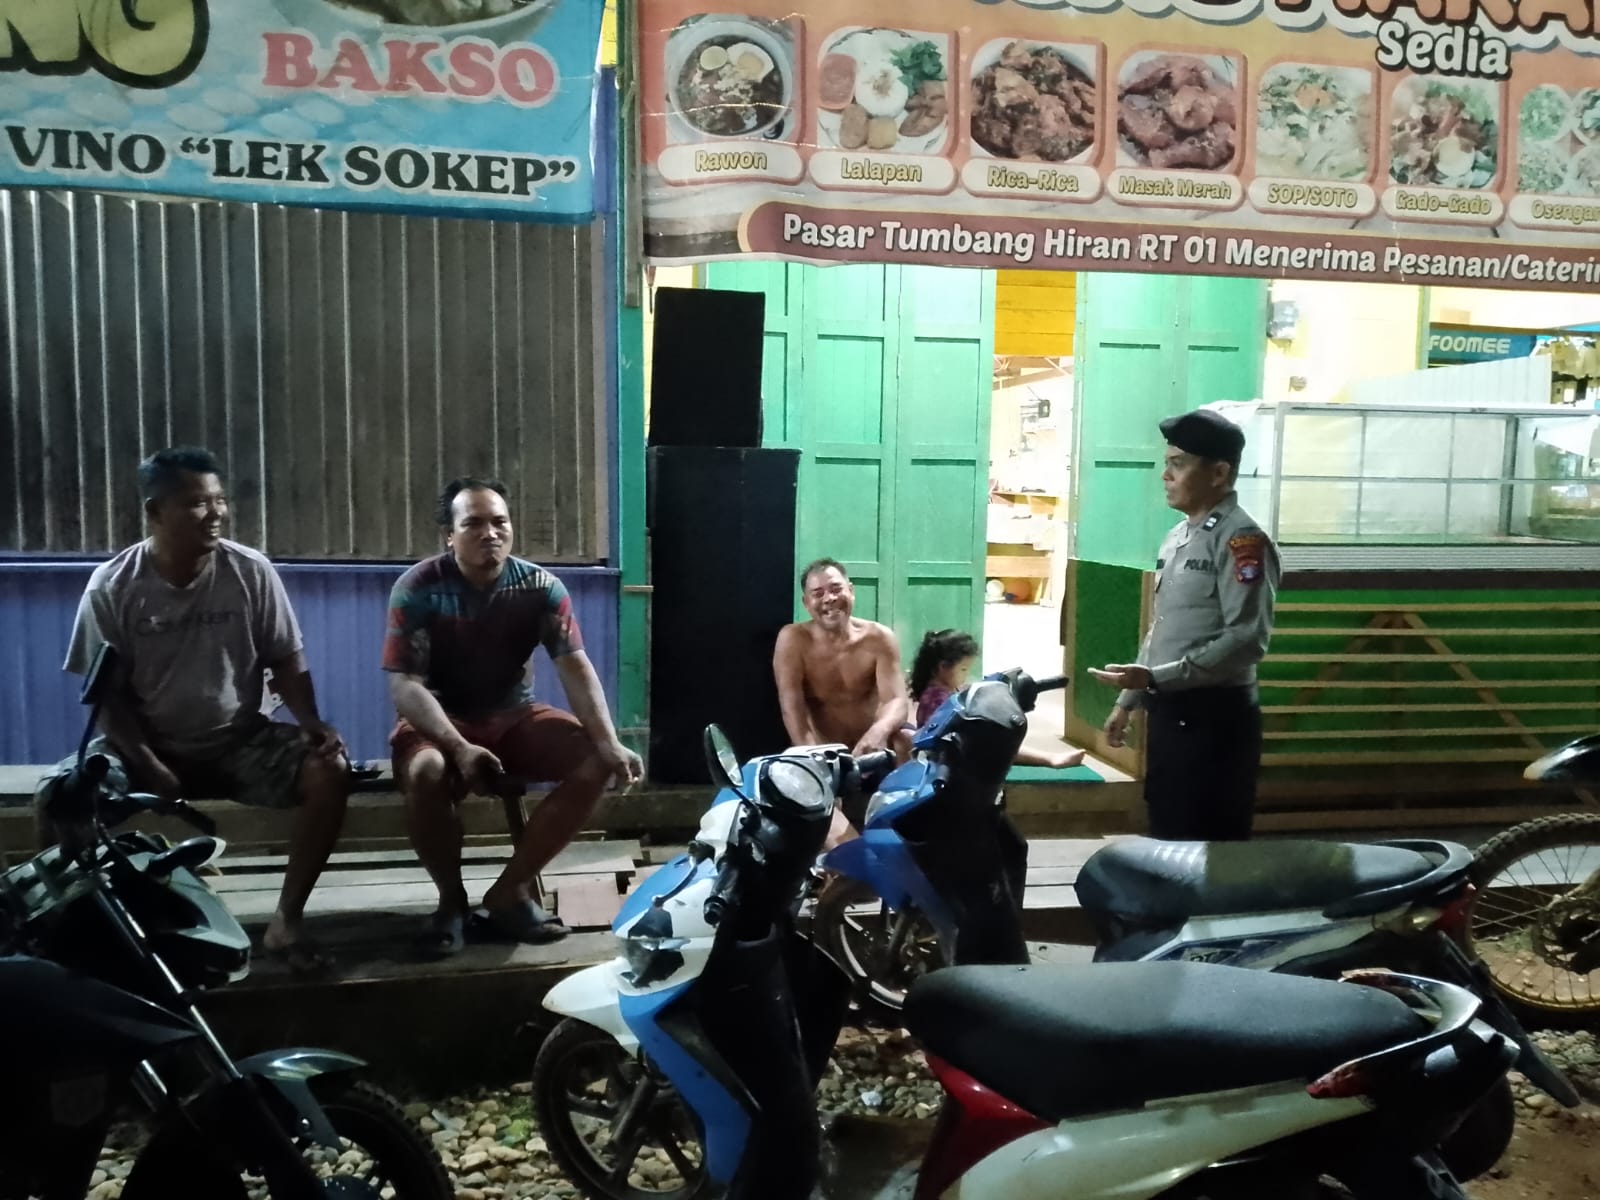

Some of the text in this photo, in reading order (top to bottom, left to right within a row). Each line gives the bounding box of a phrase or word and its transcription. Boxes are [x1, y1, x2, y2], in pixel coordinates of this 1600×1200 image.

[1376, 20, 1508, 76] Sedia
[263, 33, 554, 102] BAKSO
[5, 126, 165, 173] VINO
[695, 149, 767, 171] Rawon
[841, 158, 922, 184] Lalapan
[987, 166, 1079, 192] Rica-Rica
[1119, 176, 1231, 199] Masak Merah
[1268, 184, 1357, 208] SOP/SOTO
[1396, 190, 1491, 214] Gado-Gado
[784, 213, 874, 249] Pasar
[881, 221, 1034, 262] Tumbang
[1044, 229, 1130, 260] Hiran
[1139, 234, 1178, 261] RT
[1184, 237, 1216, 263] 01
[1225, 238, 1376, 272] Menerima
[1429, 335, 1510, 353] FOOMEE
